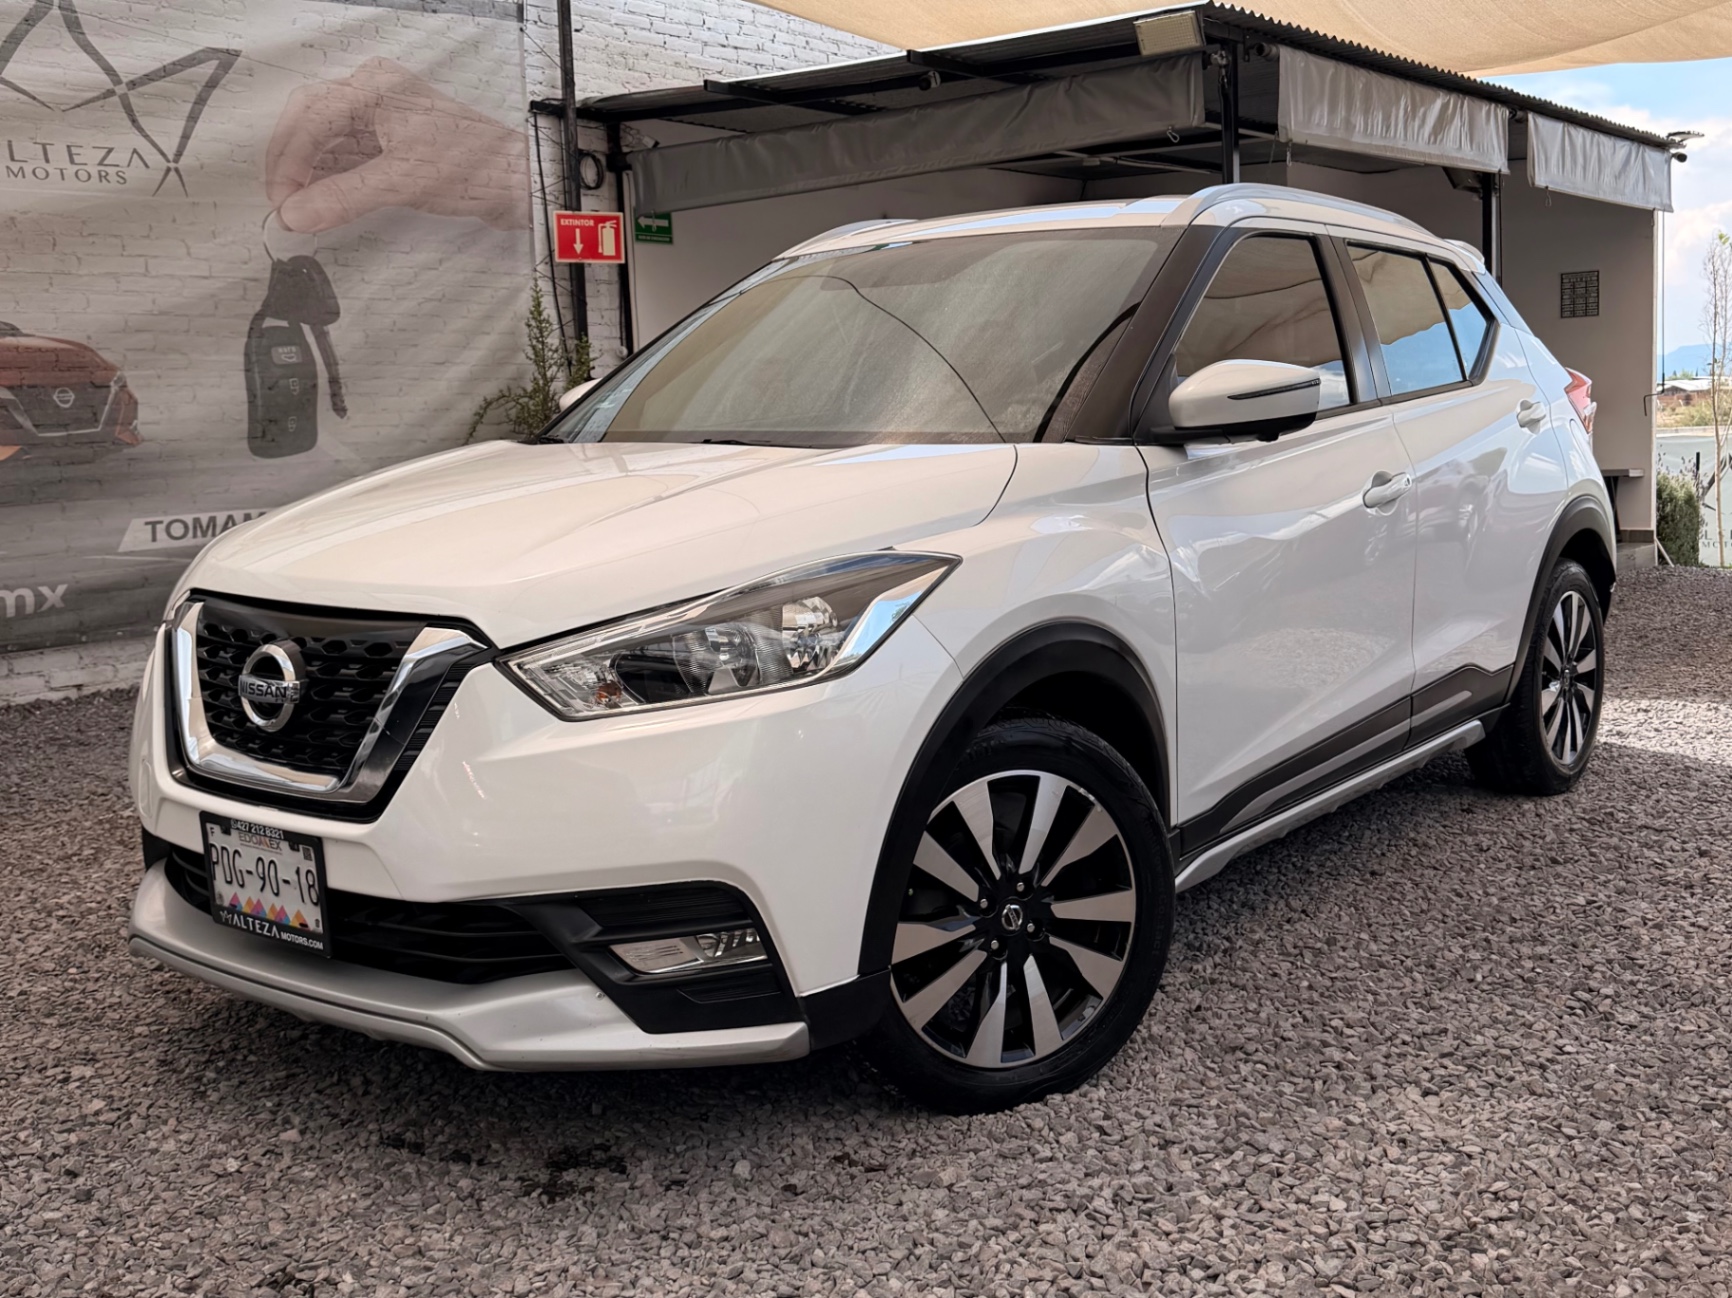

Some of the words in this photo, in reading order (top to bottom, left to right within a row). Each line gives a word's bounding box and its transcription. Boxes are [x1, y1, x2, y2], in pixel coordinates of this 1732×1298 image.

[6, 165, 127, 185] MOTORS
[560, 218, 595, 227] EXTINTOR
[240, 681, 287, 698] NISSAN
[237, 820, 250, 831] 427
[250, 823, 265, 836] 212
[265, 826, 285, 840] 8321
[208, 842, 320, 907] PDG-90-18
[232, 914, 280, 939] ALTEZA
[280, 931, 324, 951] MOTORS.COM
